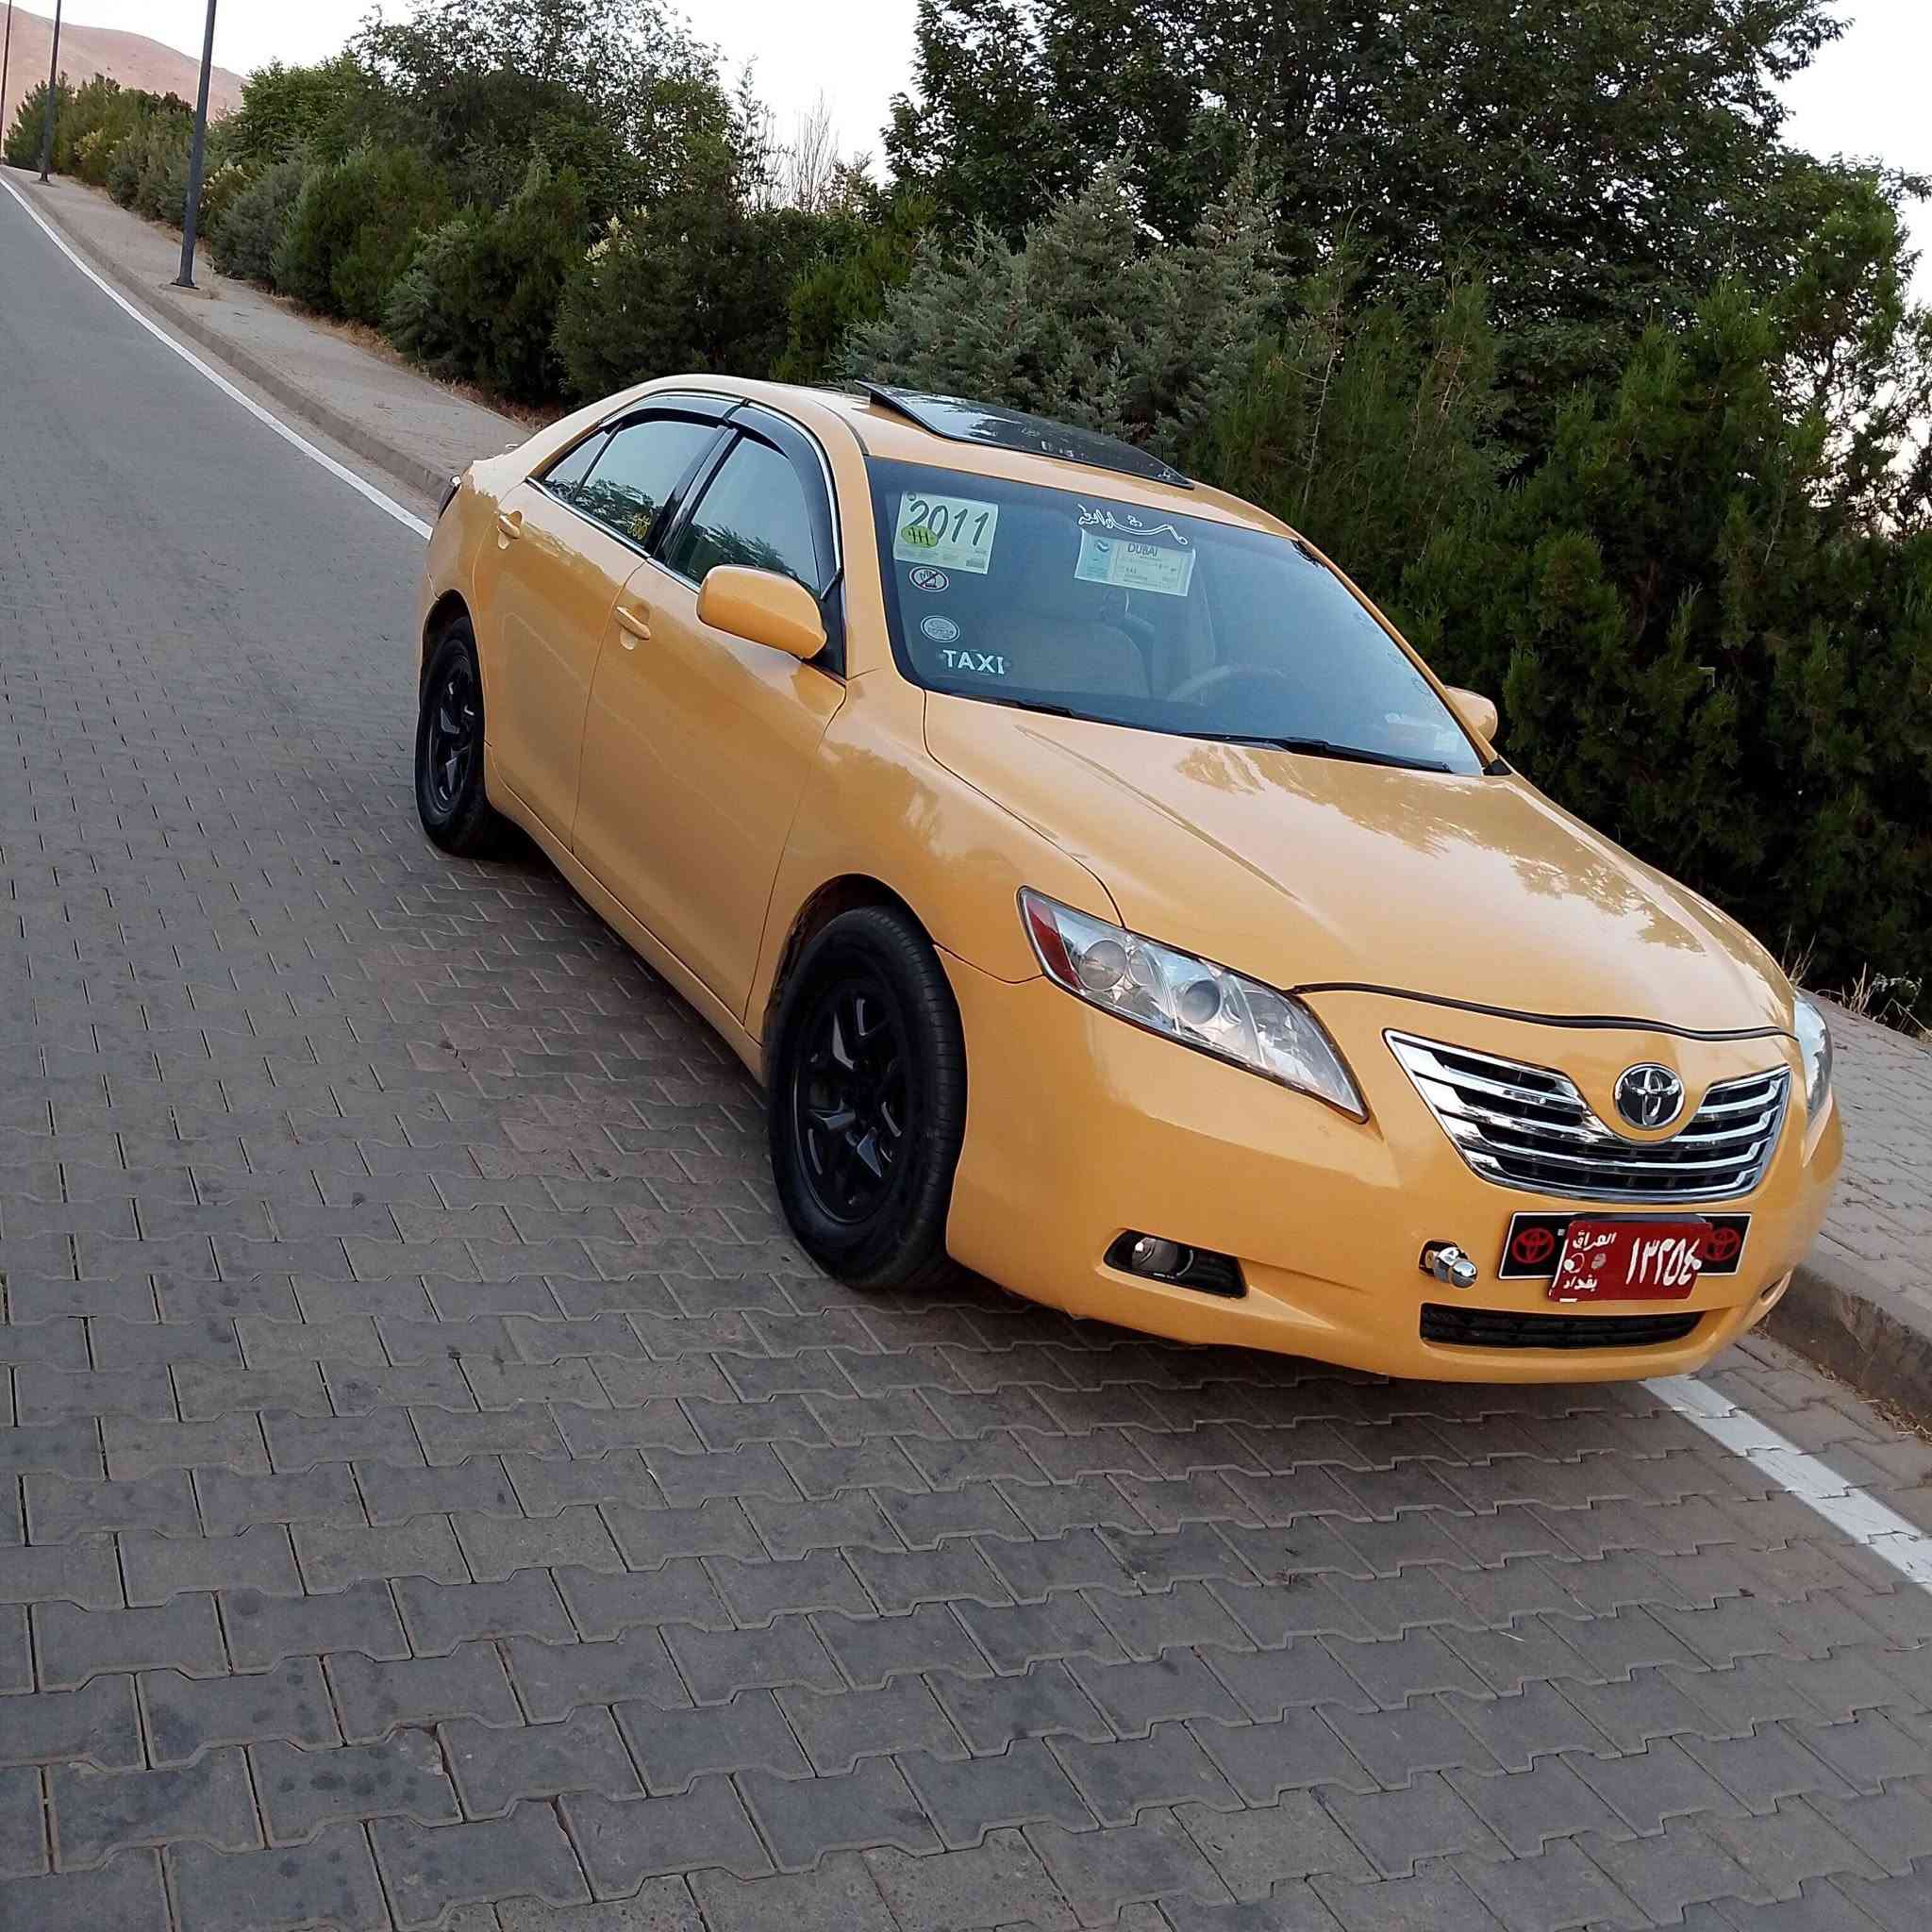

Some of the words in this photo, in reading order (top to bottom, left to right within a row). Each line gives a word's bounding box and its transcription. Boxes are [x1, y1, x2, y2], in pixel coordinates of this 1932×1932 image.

[908, 500, 990, 546] 2011
[1127, 542, 1158, 558] DUBAI
[942, 649, 1005, 675] TAXI
[1573, 1230, 1618, 1252] العراق
[1562, 1274, 1599, 1292] بغداد
